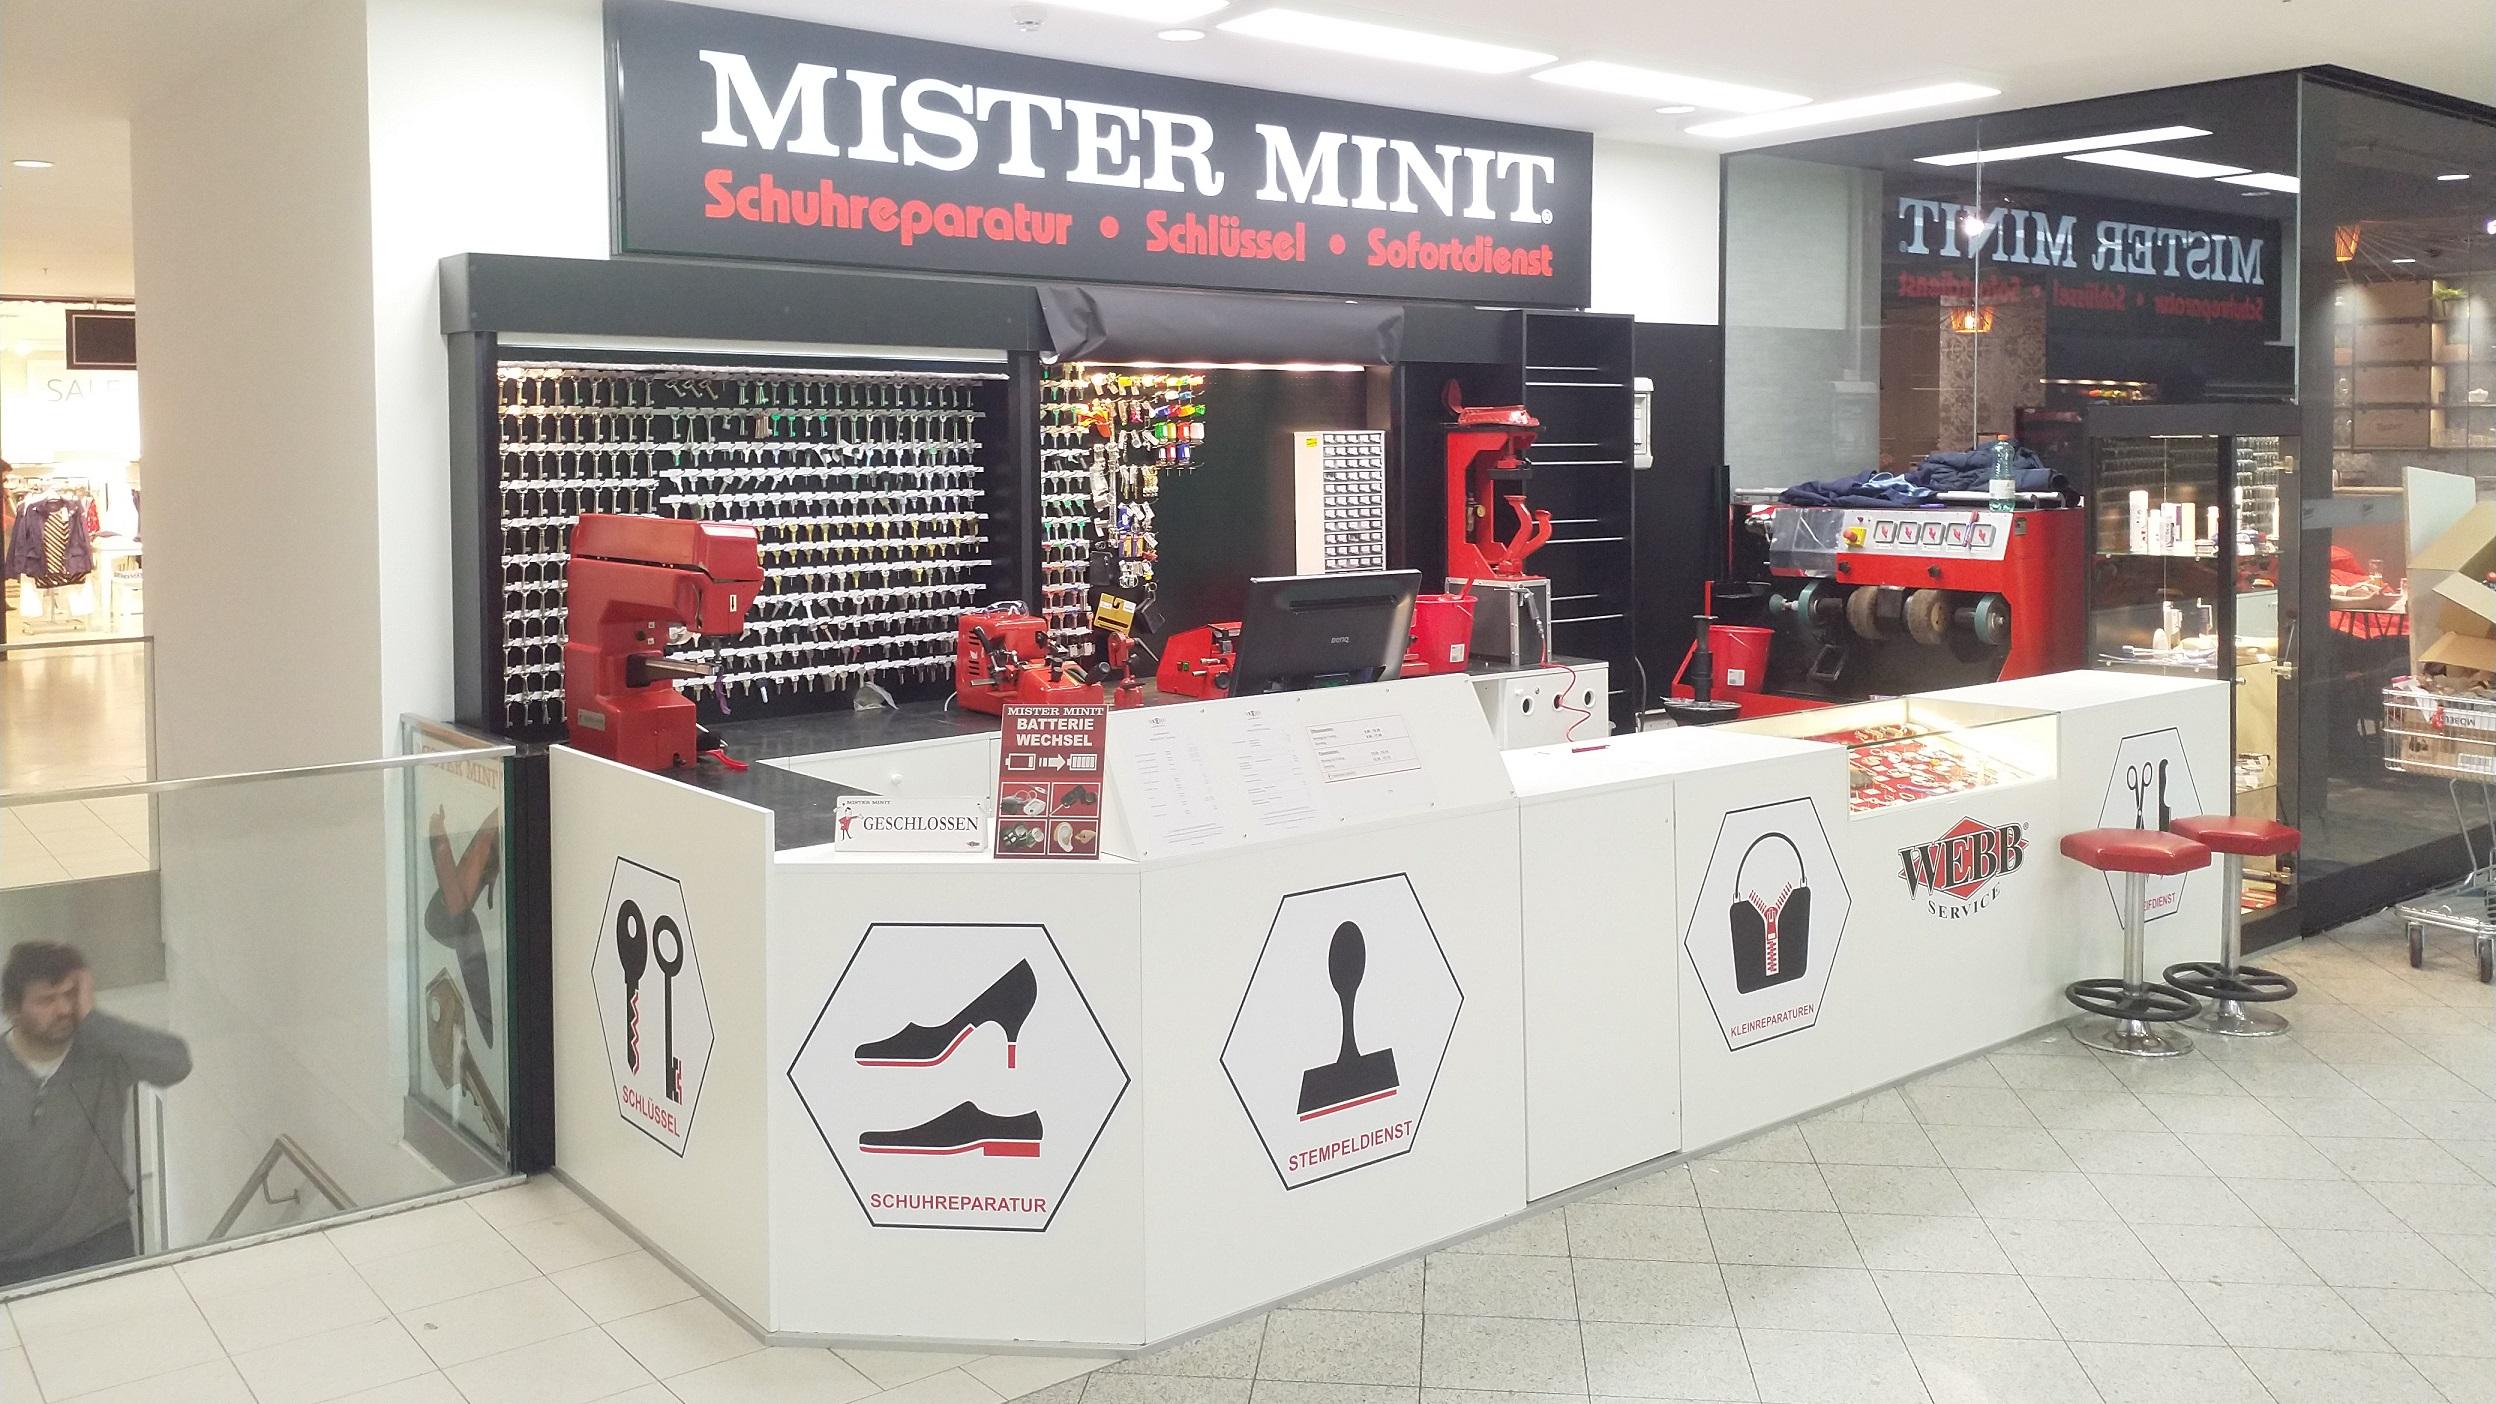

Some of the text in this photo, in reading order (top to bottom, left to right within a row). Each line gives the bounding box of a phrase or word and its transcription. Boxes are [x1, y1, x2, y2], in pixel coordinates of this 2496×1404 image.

[700, 50, 1224, 197] MISTER
[704, 168, 1553, 276] Schuhreparatur Schlüssel Sofortdienst
[1007, 707, 1104, 716] MISTER MINIT
[1017, 718, 1094, 731] BATTERIE
[1016, 734, 1093, 747] WECHSEL
[863, 816, 979, 831] GESCHLOSSEN
[1898, 822, 2025, 901] WEBB
[1928, 881, 2001, 920] SERVICE
[1730, 1003, 1815, 1037] KLEINREPARATUREN
[622, 1084, 681, 1138] SCHLÜSSEL
[1288, 1120, 1413, 1172] STEMPELDIENST
[870, 1194, 1047, 1213] SCHUHREPARATUR
